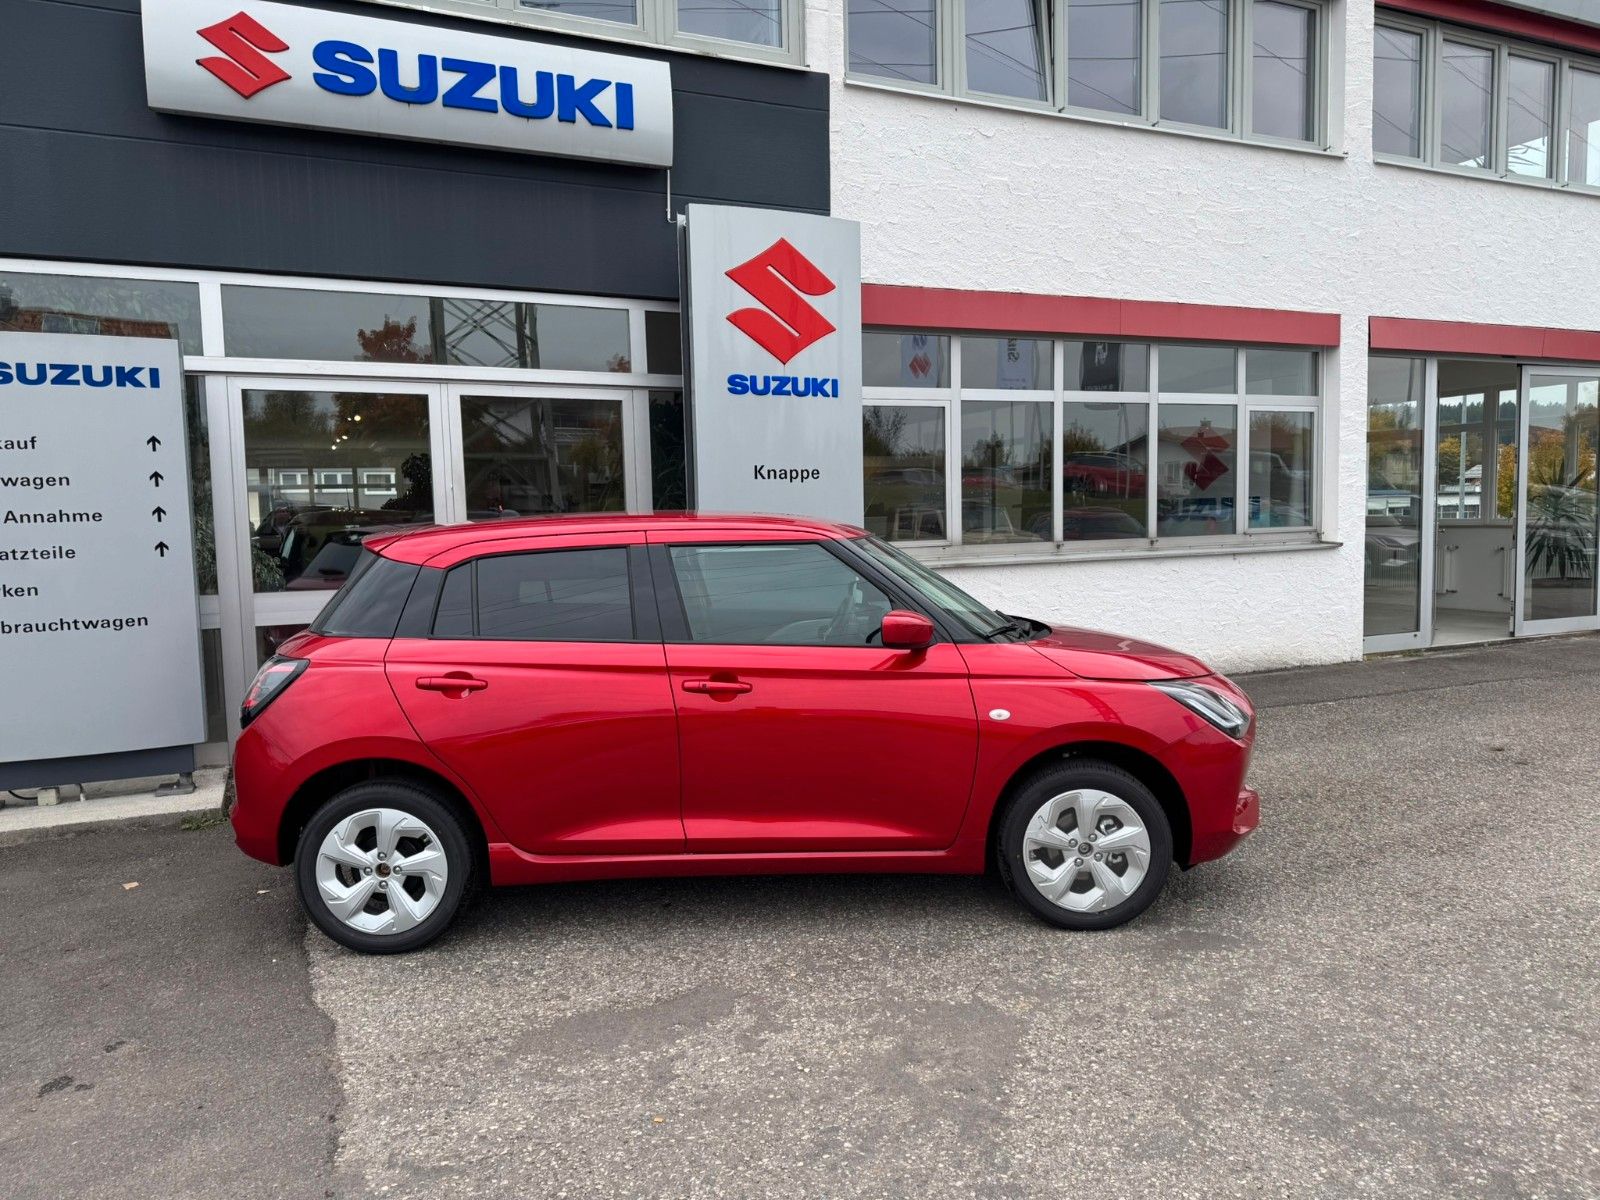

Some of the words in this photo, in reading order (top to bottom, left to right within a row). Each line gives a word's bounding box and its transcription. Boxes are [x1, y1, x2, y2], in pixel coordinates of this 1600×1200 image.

[312, 40, 635, 131] SUZUKI
[727, 374, 839, 398] SUZUKI
[0, 435, 37, 450] auf
[753, 465, 820, 483] Knappe
[3, 509, 103, 524] Annahme
[0, 584, 39, 598] ken
[1, 616, 149, 634] brauchtwagen
